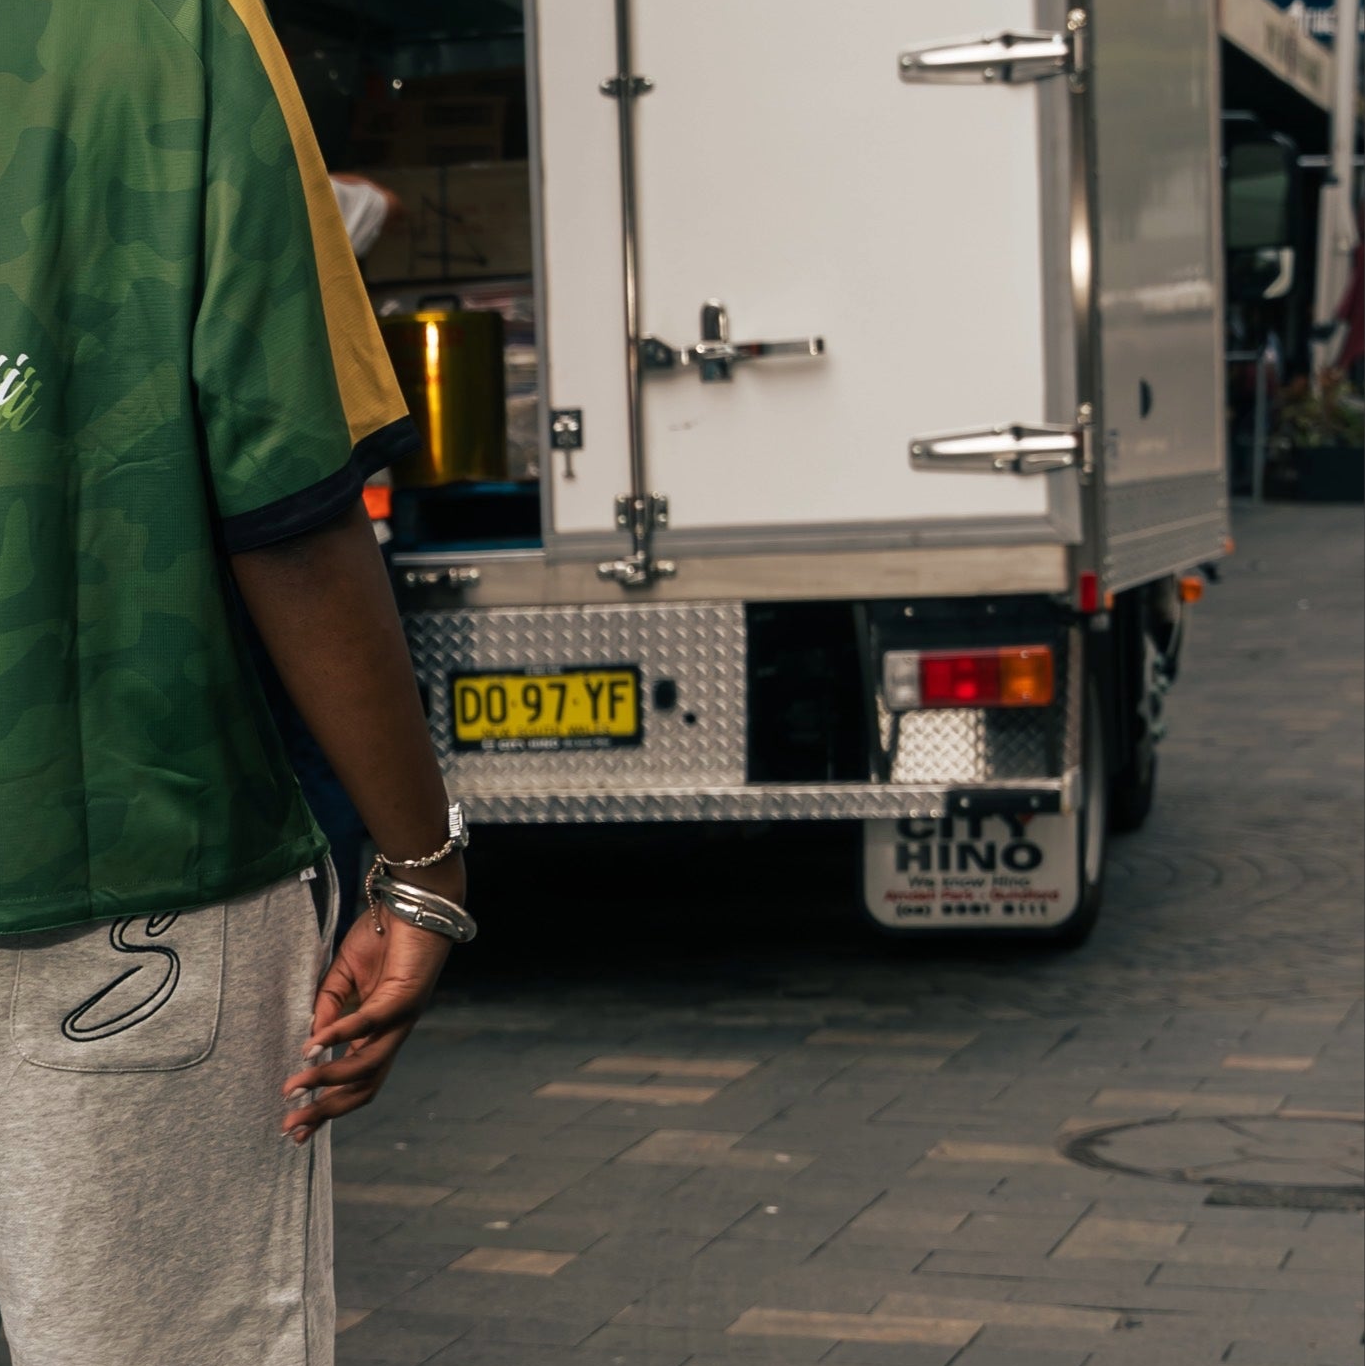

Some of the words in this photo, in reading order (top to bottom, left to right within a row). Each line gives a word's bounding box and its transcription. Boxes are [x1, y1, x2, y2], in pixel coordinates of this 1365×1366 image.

[521, 682, 567, 724] 97
[584, 679, 629, 722] YF
[896, 814, 1030, 841] CITY
[895, 842, 1043, 872] HINO
